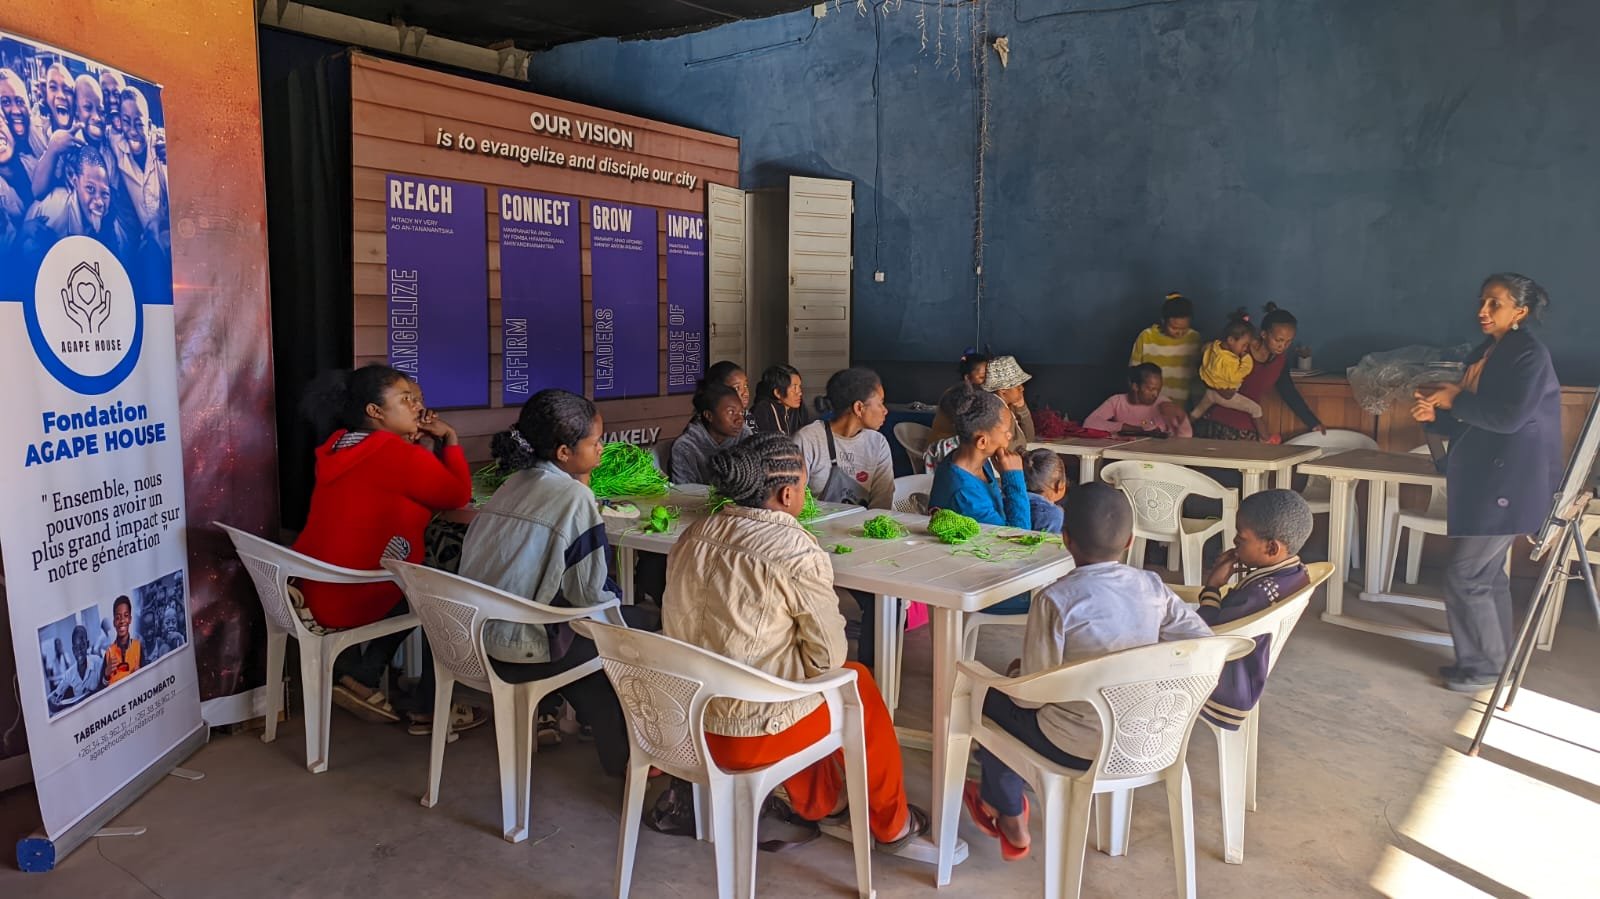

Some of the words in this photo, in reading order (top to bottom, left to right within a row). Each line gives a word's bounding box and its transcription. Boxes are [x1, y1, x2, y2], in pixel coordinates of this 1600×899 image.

[530, 111, 571, 137] OUR
[576, 120, 633, 148] VISION
[436, 128, 452, 147] is
[458, 132, 476, 150] to
[481, 140, 565, 165] evangelize
[569, 153, 596, 171] and
[599, 156, 649, 180] disciple
[652, 168, 673, 183] our
[675, 171, 697, 189] city
[390, 179, 453, 214] REACH
[502, 193, 570, 227] CONNECT
[593, 205, 632, 233] GROW
[668, 214, 703, 240] IMPAC
[392, 269, 418, 383] ANGELIZE
[670, 303, 685, 326] OF
[61, 340, 90, 353] AGAPE
[95, 339, 122, 352] HOUSE
[506, 318, 529, 394] AFFIRM
[595, 308, 614, 390] LEADERS
[670, 330, 685, 386] HOUSE
[686, 332, 700, 385] PEACE
[42, 401, 148, 434] Fondation
[25, 434, 99, 467] AGAPE
[105, 423, 166, 452] HOUSE
[52, 478, 129, 513] Ensemble,
[134, 473, 162, 492] nous
[32, 541, 65, 571] plus
[69, 523, 111, 559] grand
[115, 513, 158, 540] impact
[161, 507, 180, 524] sur
[46, 508, 109, 543] pouvons
[113, 496, 147, 519] avoir
[149, 492, 163, 508] un
[48, 557, 88, 583] notre
[92, 532, 160, 572] génération
[74, 705, 127, 744] TABERNACLE
[128, 675, 176, 711] TANJOMBATO
